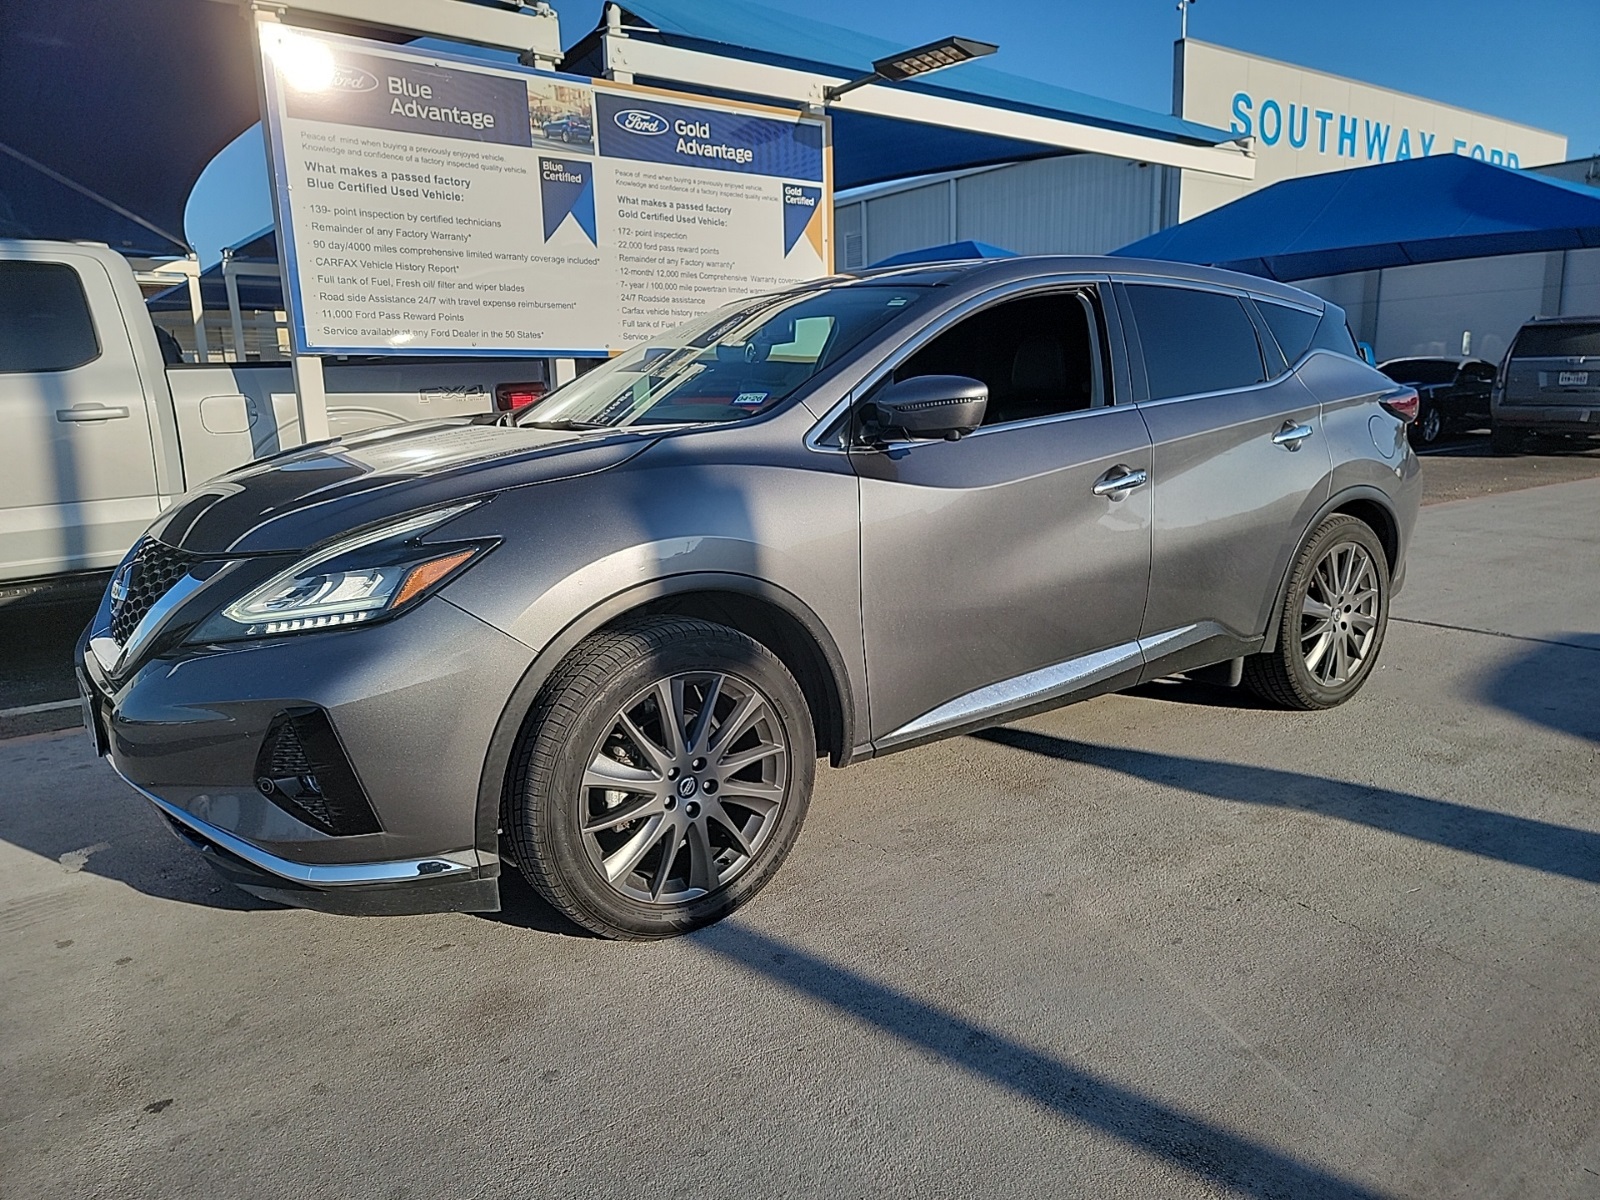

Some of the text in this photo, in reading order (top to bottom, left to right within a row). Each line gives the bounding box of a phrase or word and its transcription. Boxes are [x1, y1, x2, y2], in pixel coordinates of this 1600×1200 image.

[387, 76, 433, 100] Blue
[390, 98, 495, 130] Advantage
[624, 112, 659, 132] Ford
[674, 120, 710, 138] Gold
[1229, 91, 1436, 163] SOUTHWAY
[300, 131, 326, 141] Peace
[340, 137, 358, 145] mind
[360, 139, 380, 147] when
[382, 142, 408, 152] buying
[416, 147, 452, 157] previously
[452, 150, 480, 160] enjoyed
[676, 138, 753, 164] Advantage
[301, 142, 346, 156] Knowledge
[347, 148, 362, 156] and
[364, 150, 404, 161] confidence
[420, 157, 444, 166] factory
[446, 159, 479, 169] inspected
[480, 164, 502, 174] quality
[542, 160, 564, 172] Blue
[304, 160, 471, 189] What makes a passed factory
[543, 171, 582, 184] Certified
[615, 169, 634, 177] Peace
[674, 176, 692, 184] buying
[697, 180, 723, 188] previously
[306, 178, 464, 202] Blue Certified Used Vehicle:
[616, 180, 646, 188] Knowledge
[660, 184, 688, 192] confidence
[701, 188, 718, 196] factory
[720, 191, 744, 199] inspected
[785, 186, 802, 196] Gold
[617, 195, 639, 205] What
[640, 198, 667, 208] makes
[676, 202, 704, 212] passed
[706, 204, 732, 215] factory
[785, 196, 814, 206] Certified
[310, 204, 502, 228] 139- point inspection by certified technicians
[618, 210, 728, 227] Gold Certified Used Vehicle:
[312, 222, 362, 234] Remainder
[366, 226, 374, 235] of
[376, 230, 393, 238] any
[396, 228, 428, 240] Factory
[618, 228, 634, 236] 172-
[654, 231, 688, 240] inspection
[313, 240, 326, 249] 90
[328, 241, 371, 252] day/4000
[374, 244, 398, 254] miles
[400, 246, 464, 258] comprehensive
[466, 250, 492, 259] limited
[494, 252, 528, 263] warranty
[530, 254, 565, 265] coverage
[644, 242, 658, 250] ford
[315, 258, 358, 268] CARFAX
[360, 260, 392, 270] Vehicle
[396, 262, 426, 273] History
[618, 254, 656, 263] Remainder
[680, 258, 704, 268] Factory
[318, 274, 525, 292] Full tank of Fuel, Fresh oil/ filter and wiper blades
[699, 272, 748, 282] Comprehensive
[750, 276, 777, 284] Warranty
[319, 292, 344, 302] Road
[347, 293, 366, 302] side
[368, 294, 416, 304] Assistance
[418, 296, 436, 304] 24/7
[438, 297, 456, 306] with
[458, 298, 481, 306] travel
[482, 300, 516, 308] expense
[620, 294, 706, 304] 24/7 Roadside assistance
[322, 310, 464, 322] 11,000 Ford Pass Reward Points
[621, 306, 644, 314] Carfax
[670, 310, 692, 318] history
[323, 326, 358, 336] Service
[360, 328, 400, 336] available
[413, 330, 428, 338] any
[431, 329, 450, 338] Ford
[452, 330, 479, 338] Dealer
[505, 330, 516, 338] 50
[622, 320, 636, 328] Full
[622, 332, 651, 340] Service
[419, 384, 484, 404] FX4
